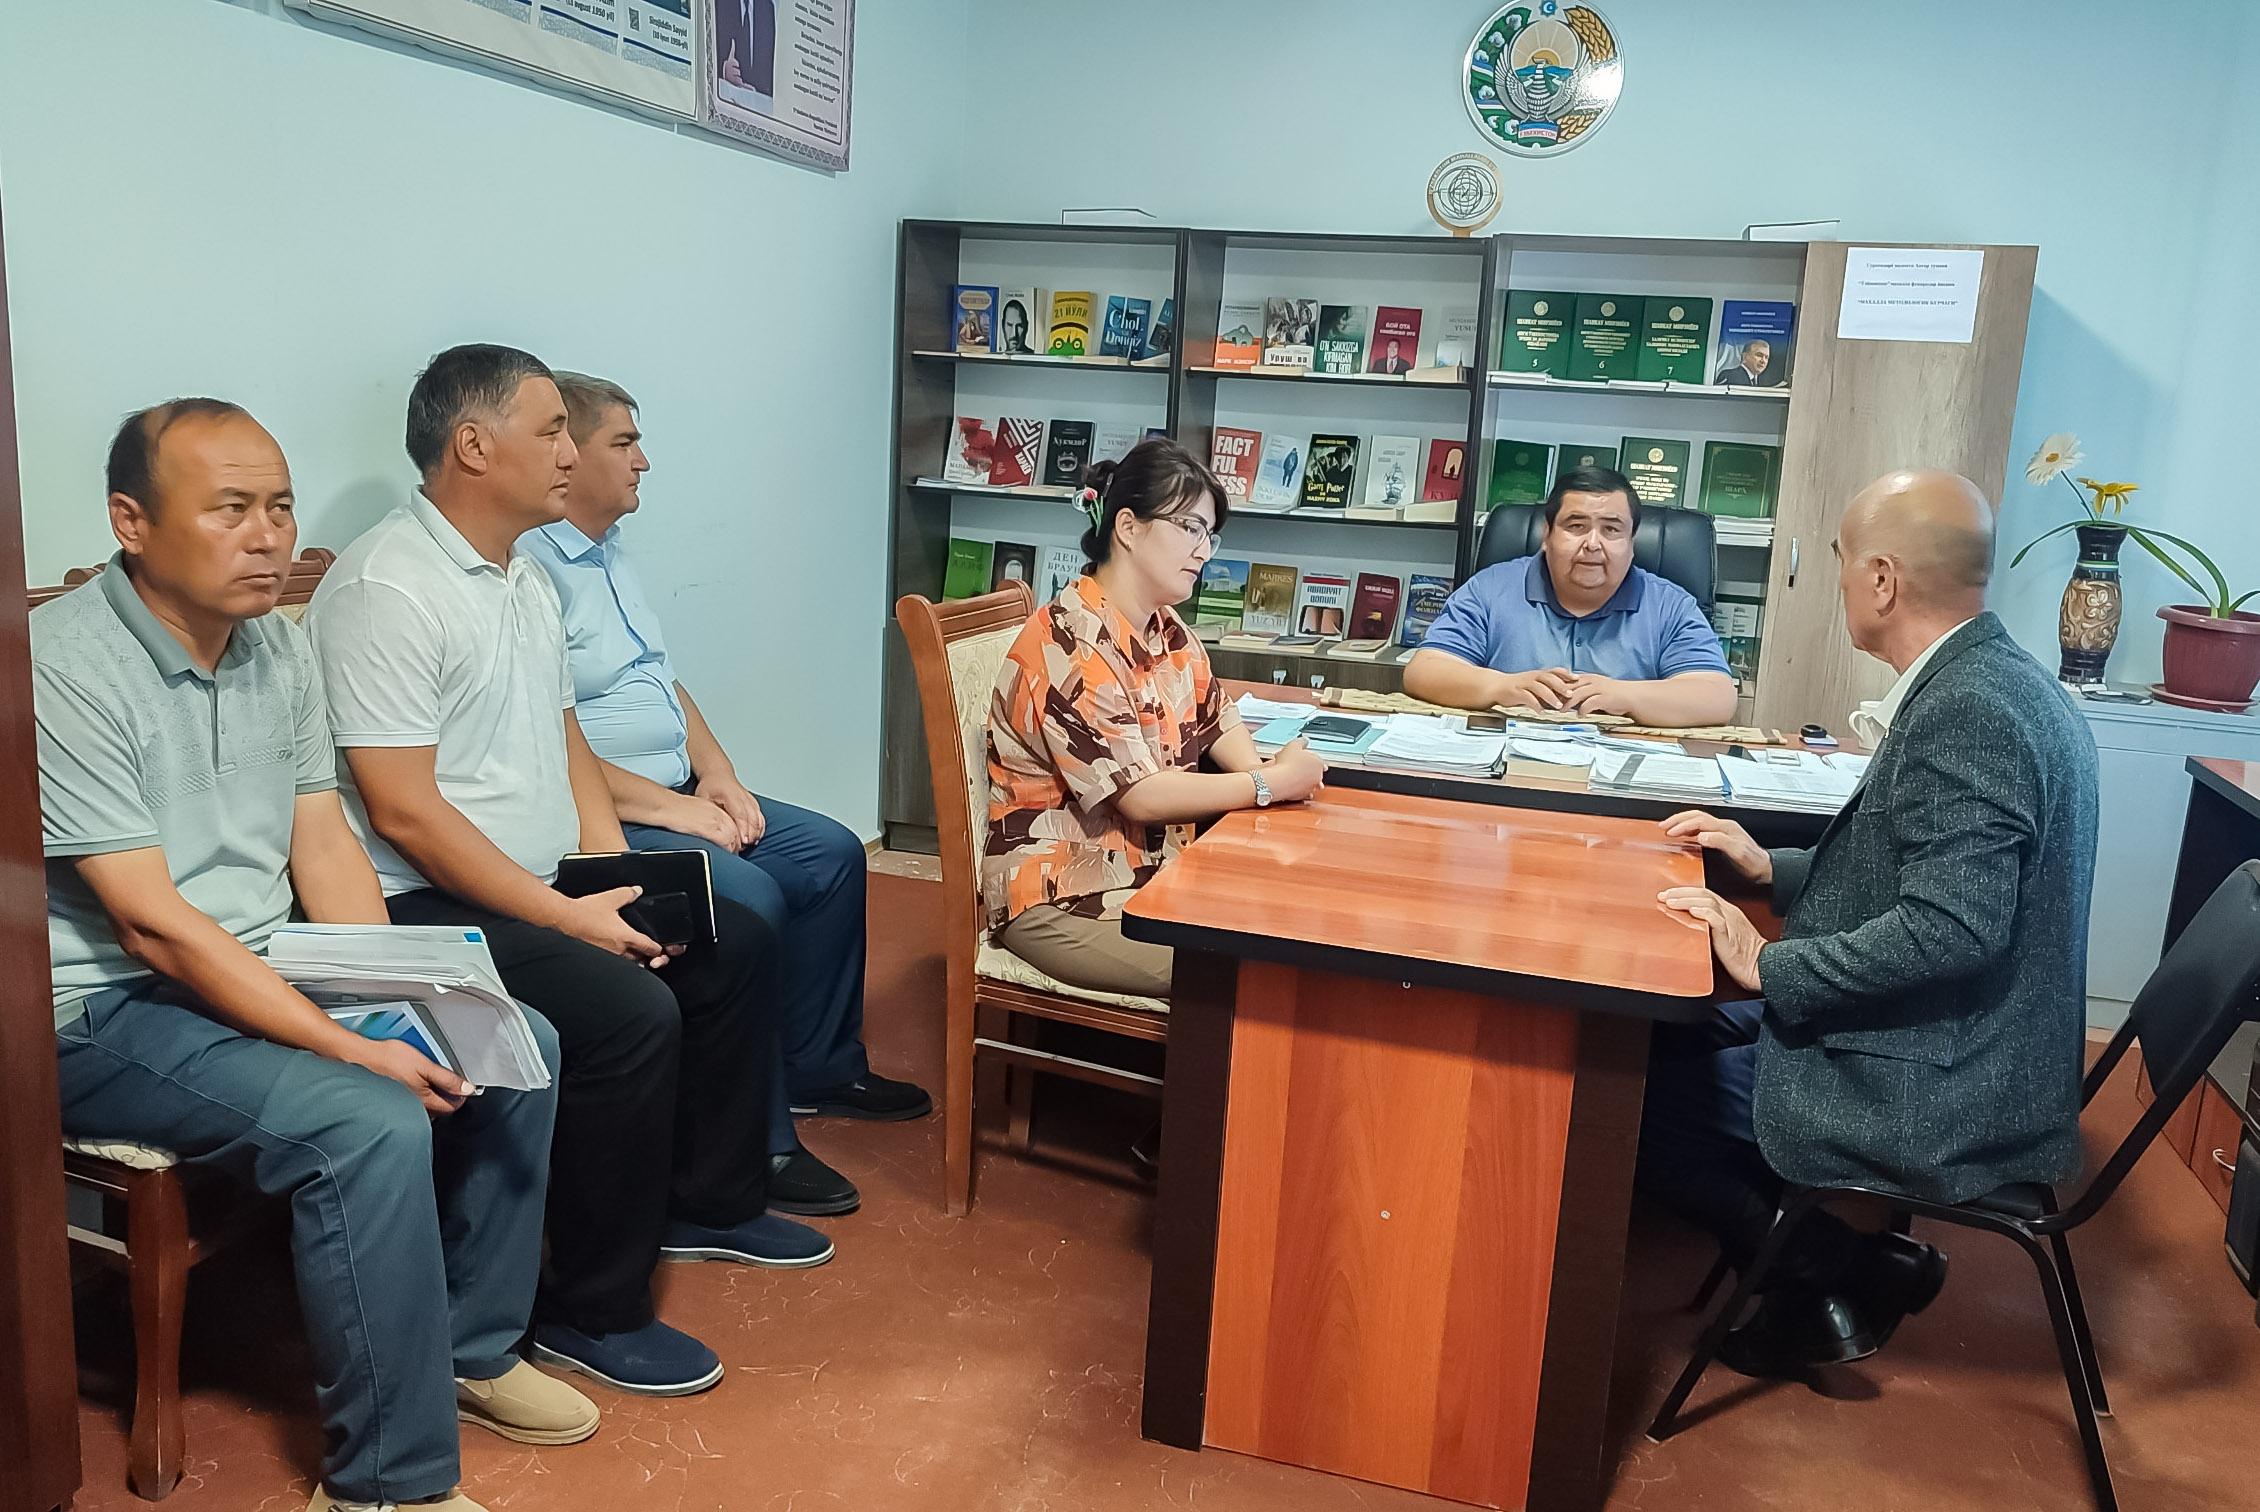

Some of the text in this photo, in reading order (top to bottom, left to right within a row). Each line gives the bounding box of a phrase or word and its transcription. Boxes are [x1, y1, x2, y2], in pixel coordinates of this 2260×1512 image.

[1532, 358, 1539, 367] 5
[1598, 360, 1605, 369] 6
[1667, 366, 1674, 375] 7
[1215, 435, 1255, 457] FACT
[1212, 454, 1238, 475] FUL
[1216, 474, 1248, 496] ESS
[1053, 552, 1078, 563] ДЕН
